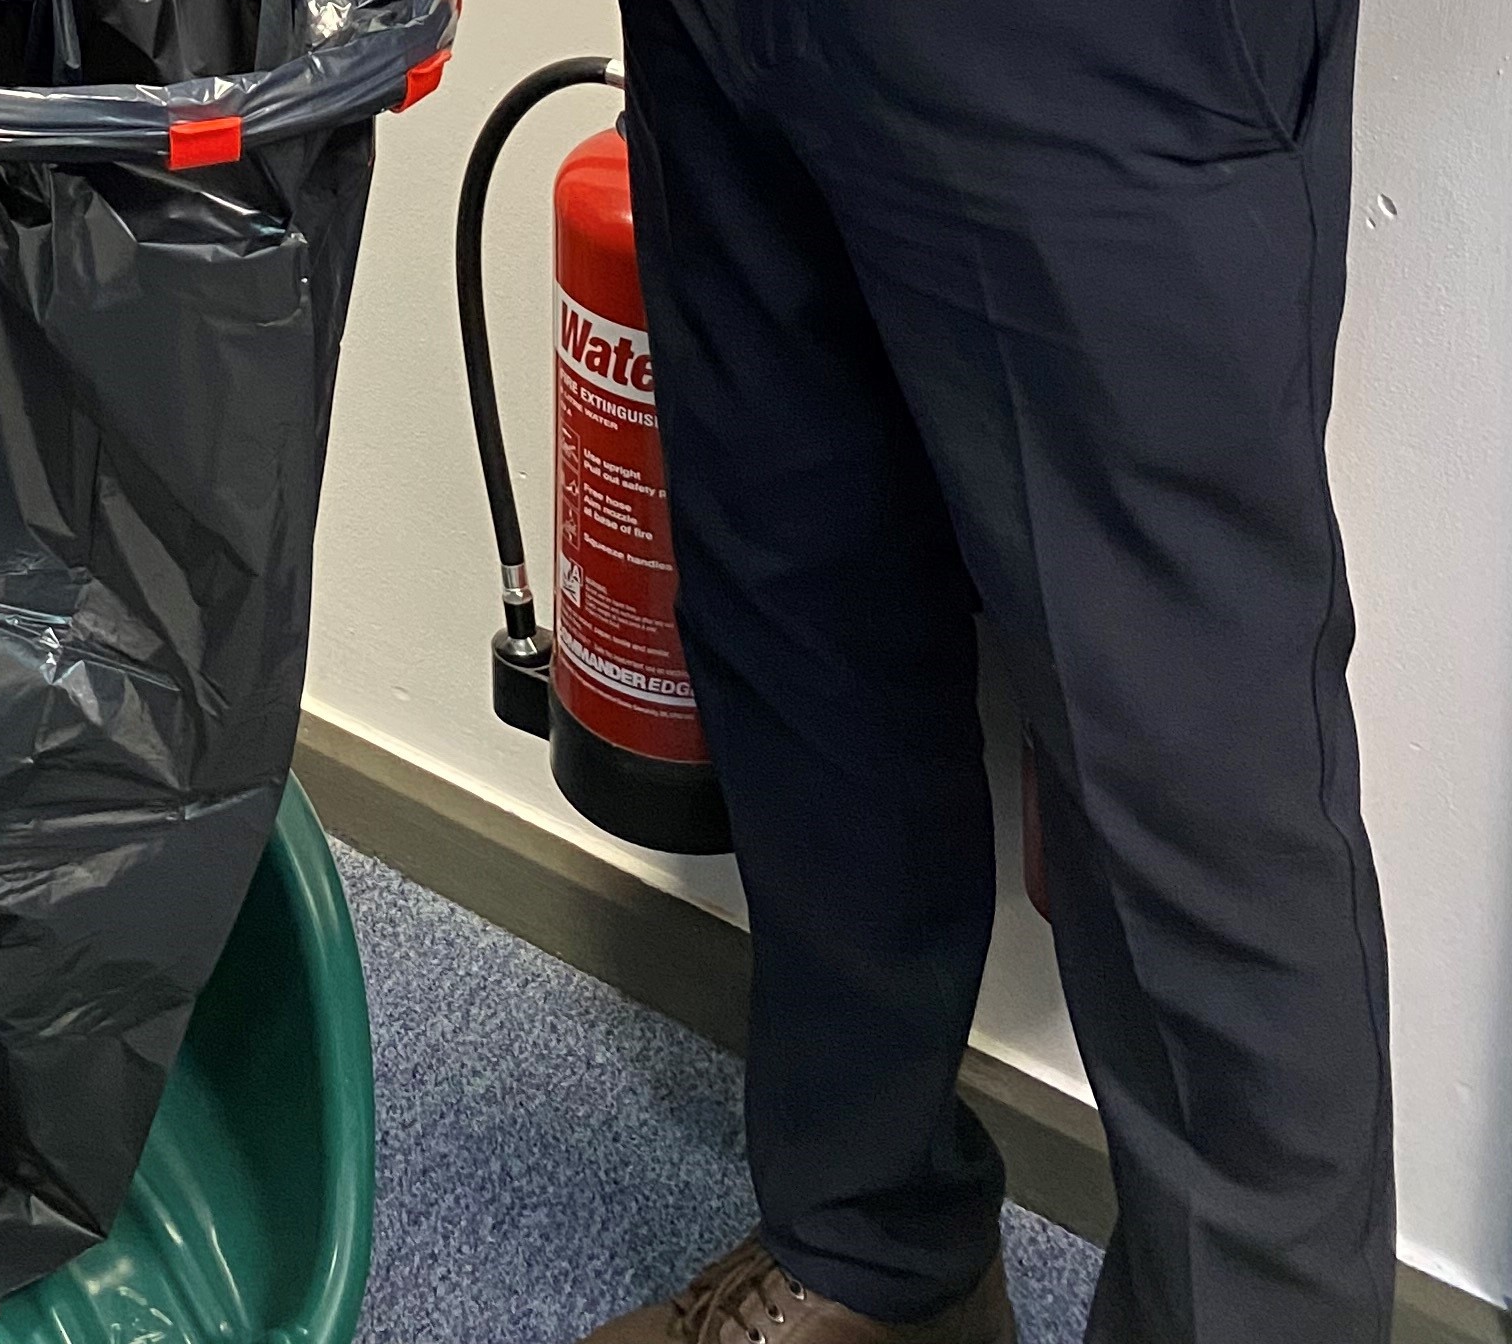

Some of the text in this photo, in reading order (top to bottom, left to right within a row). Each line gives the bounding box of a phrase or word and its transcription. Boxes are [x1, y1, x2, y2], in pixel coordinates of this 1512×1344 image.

[561, 300, 655, 393] Wate
[580, 386, 659, 429] EXTINGUIS
[584, 408, 619, 430] WATER
[583, 448, 641, 481] Use upright
[583, 460, 601, 477] Pull
[602, 472, 620, 486] out
[621, 480, 656, 497] safety
[583, 482, 632, 513] Free hose
[583, 495, 638, 525] Aim nozzle
[593, 511, 618, 530] base
[620, 525, 632, 535] of
[633, 527, 653, 541] fire
[583, 532, 673, 572] Squeeze handles
